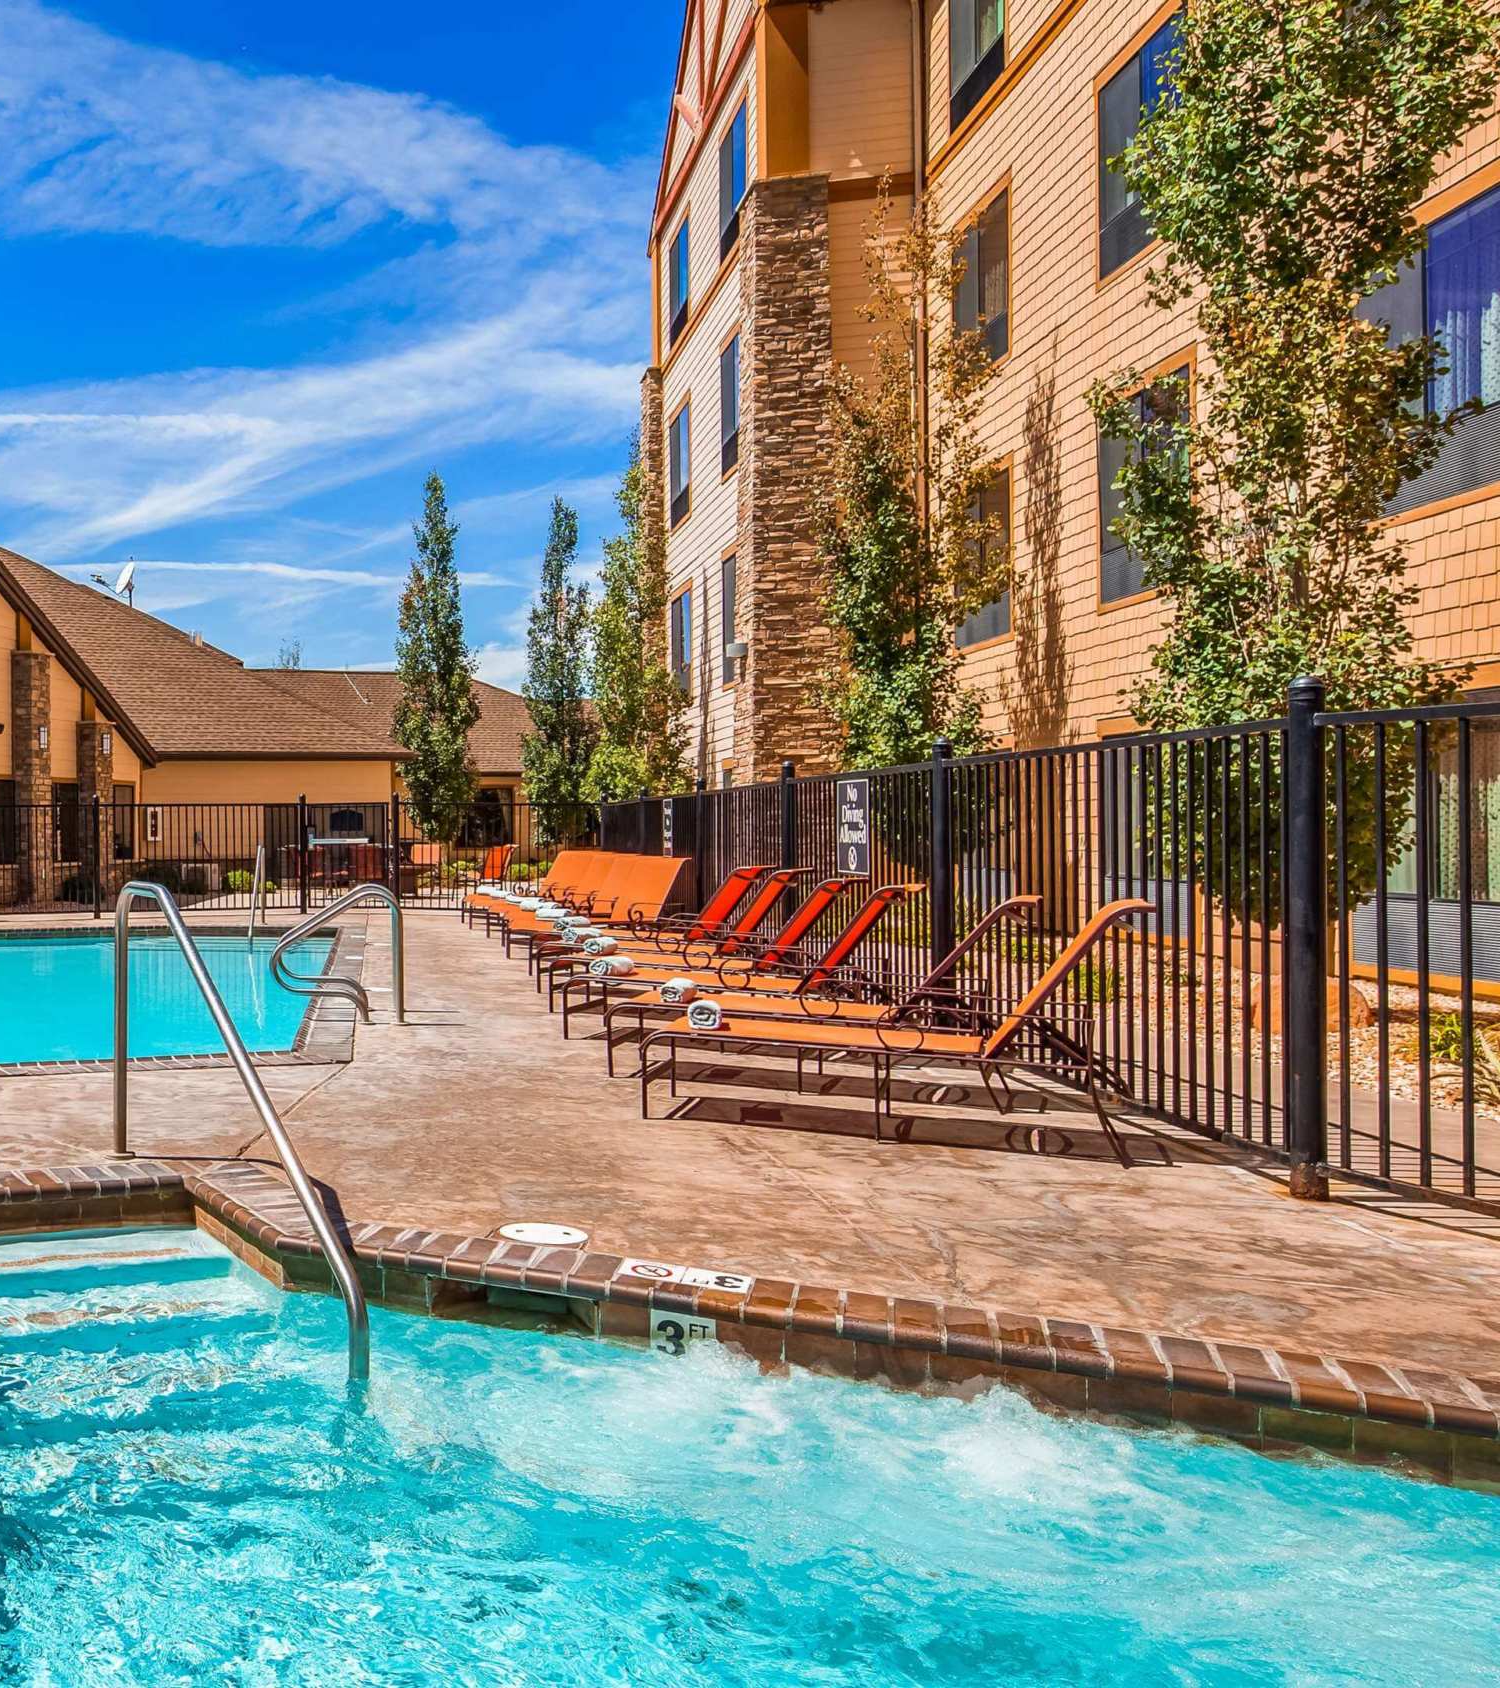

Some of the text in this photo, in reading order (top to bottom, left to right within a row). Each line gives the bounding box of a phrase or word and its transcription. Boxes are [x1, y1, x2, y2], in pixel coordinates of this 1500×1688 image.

[847, 784, 857, 802] No
[842, 803, 863, 828] Diving
[840, 824, 866, 844] Allowed
[657, 1320, 709, 1357] 3 FT
